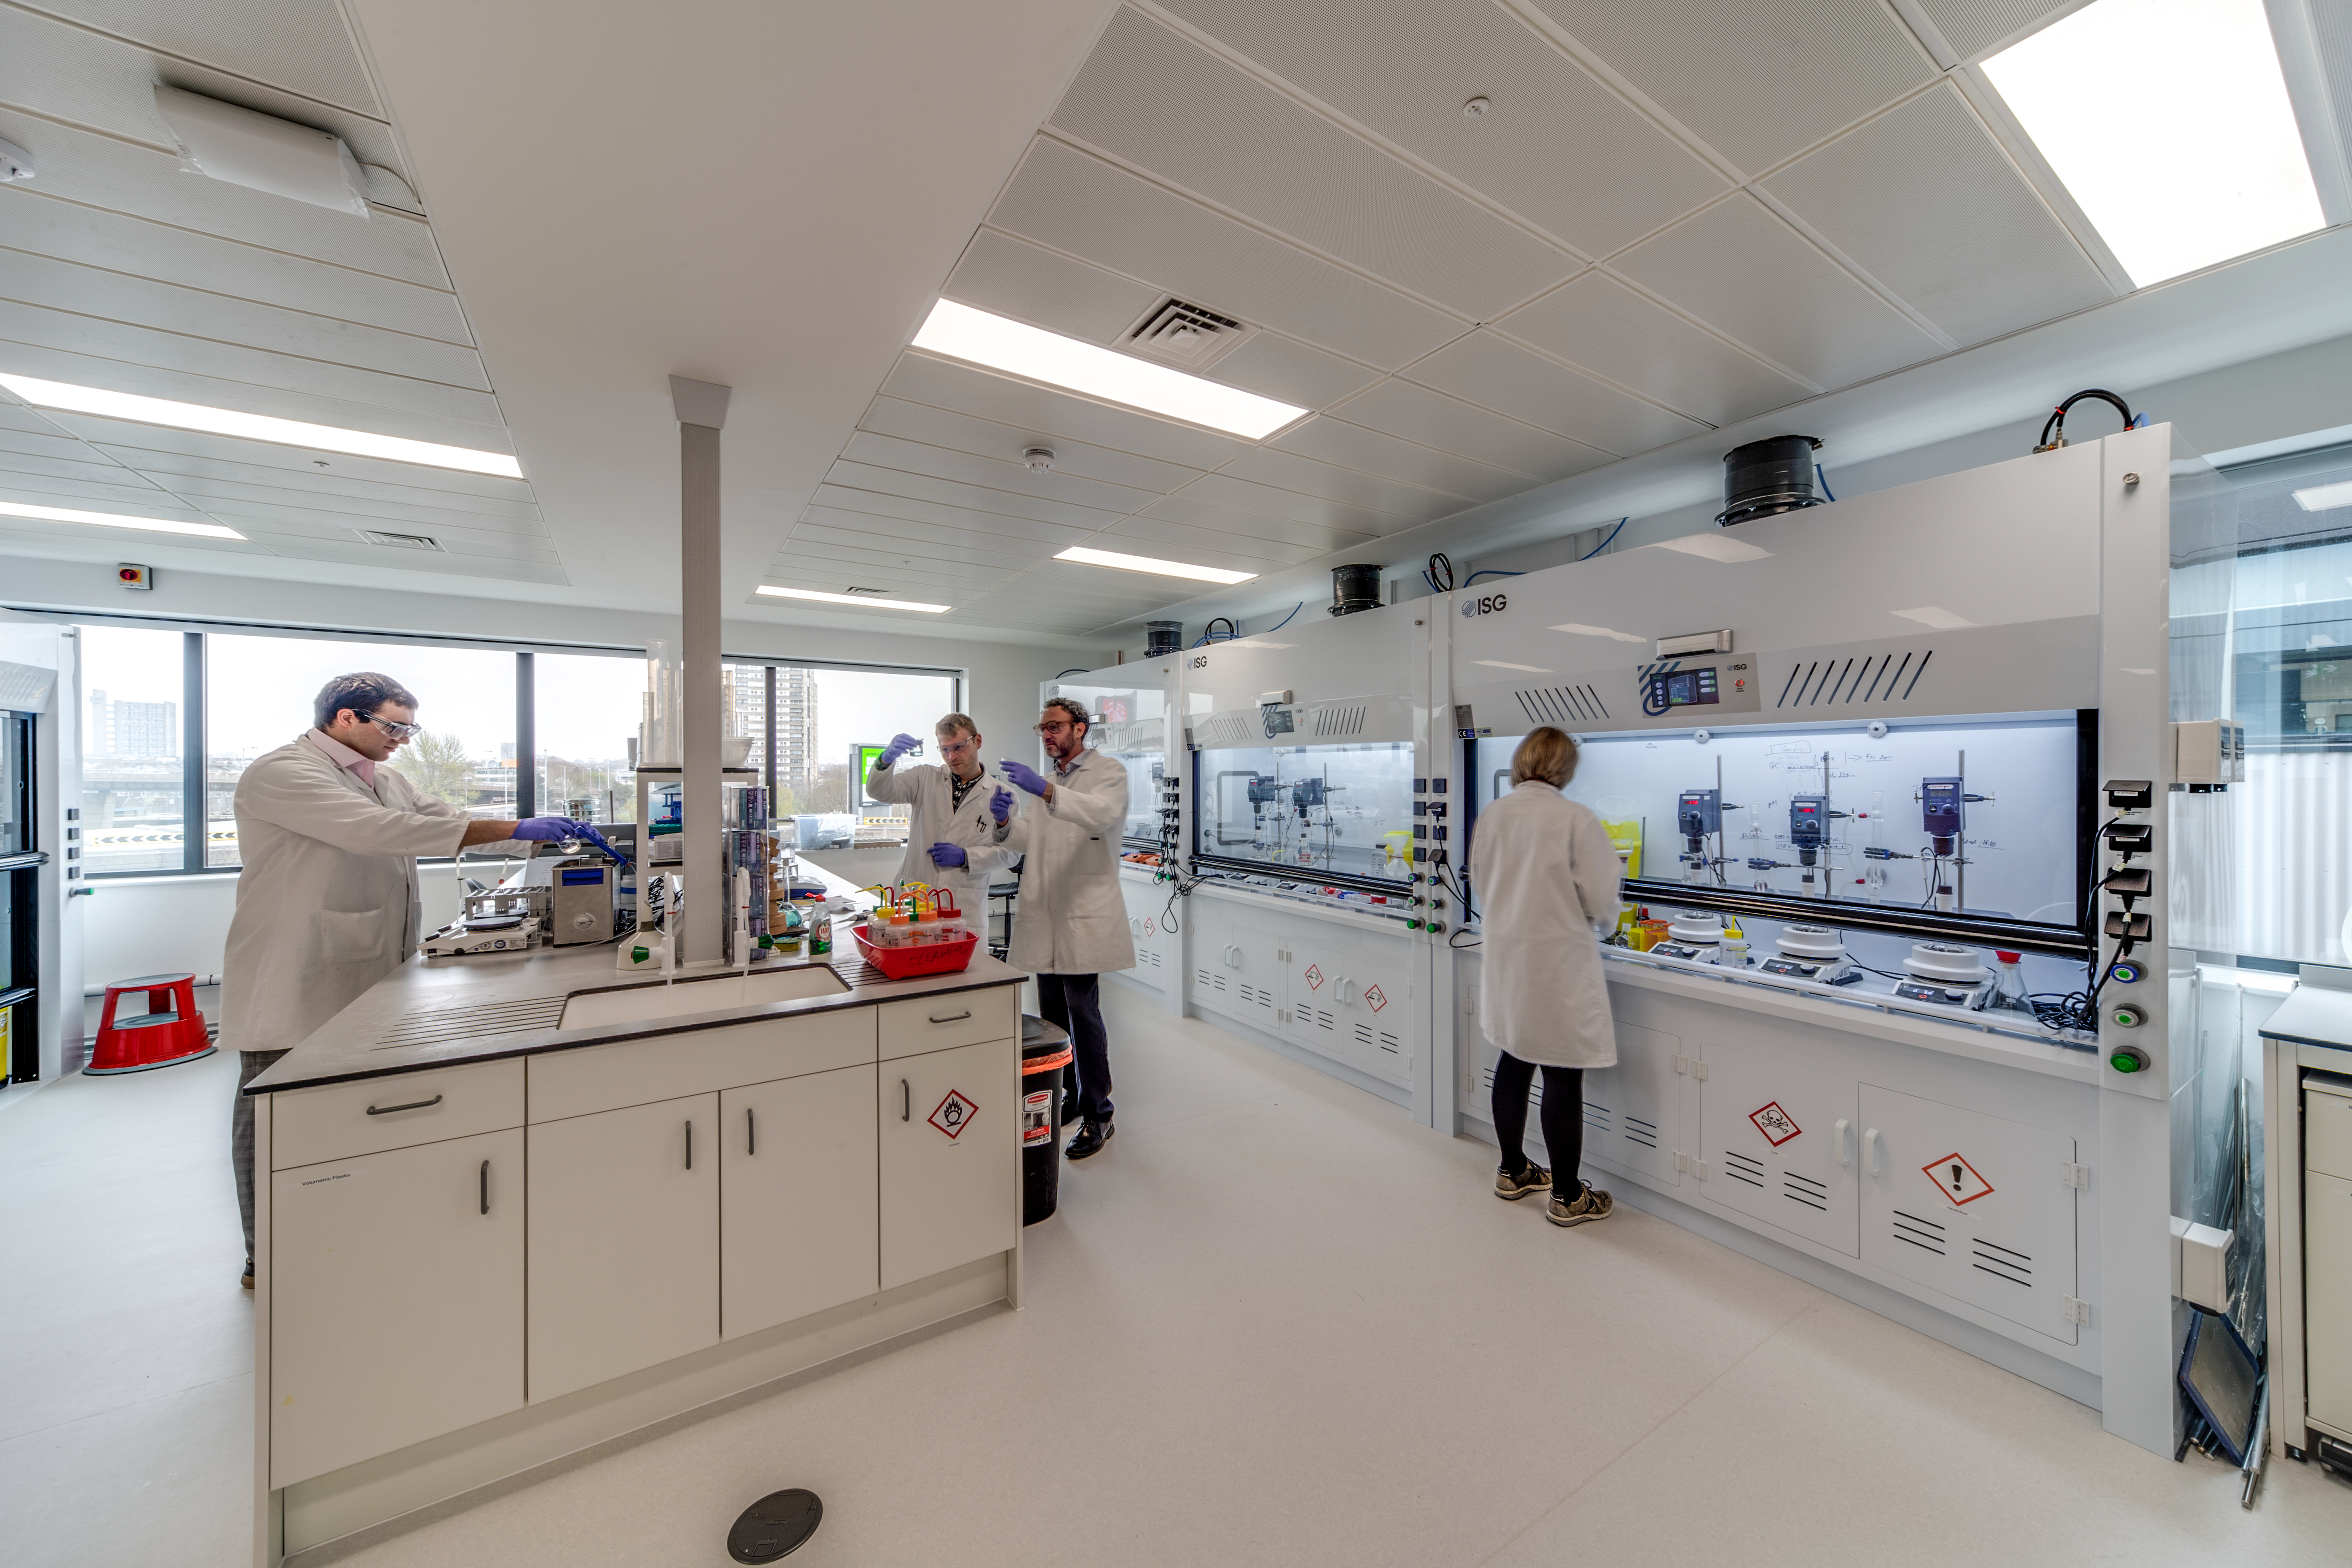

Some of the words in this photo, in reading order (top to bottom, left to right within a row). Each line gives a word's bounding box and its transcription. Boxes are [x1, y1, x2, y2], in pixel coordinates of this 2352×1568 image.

[1478, 594, 1507, 615] ISG
[1194, 656, 1207, 669] ISG
[302, 1177, 331, 1186] Volumetric
[1946, 1206, 1968, 1216] Hazardous
